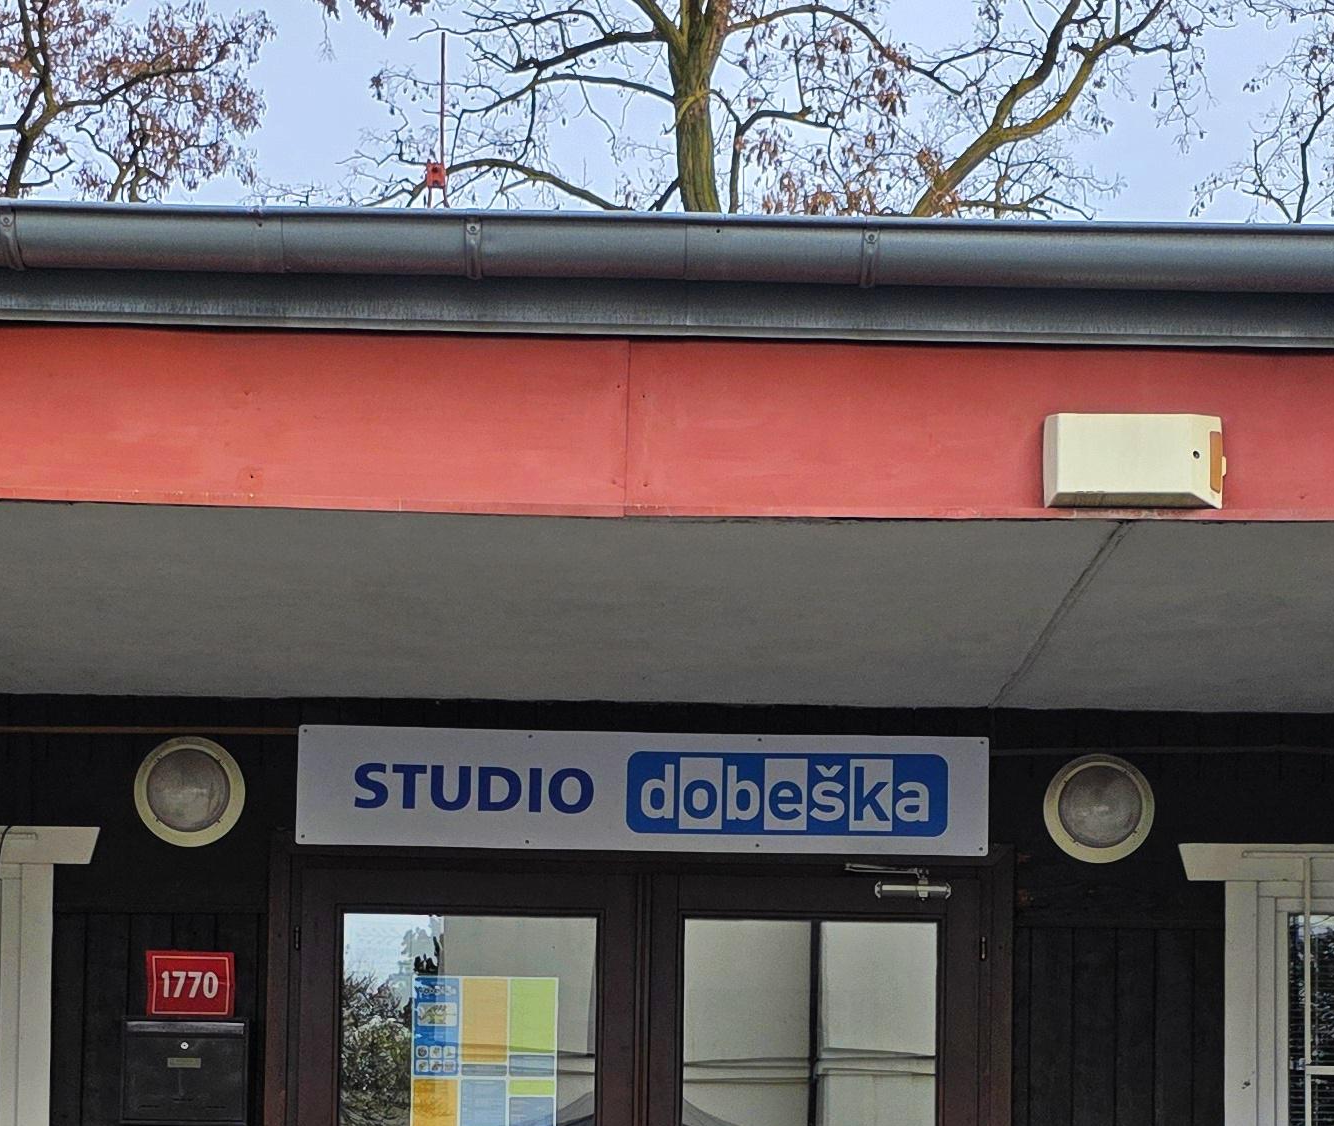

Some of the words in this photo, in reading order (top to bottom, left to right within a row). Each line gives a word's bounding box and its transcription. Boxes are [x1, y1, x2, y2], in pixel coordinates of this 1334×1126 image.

[353, 761, 595, 815] STUDIO
[639, 763, 931, 824] dobeška
[161, 970, 219, 999] 1770
